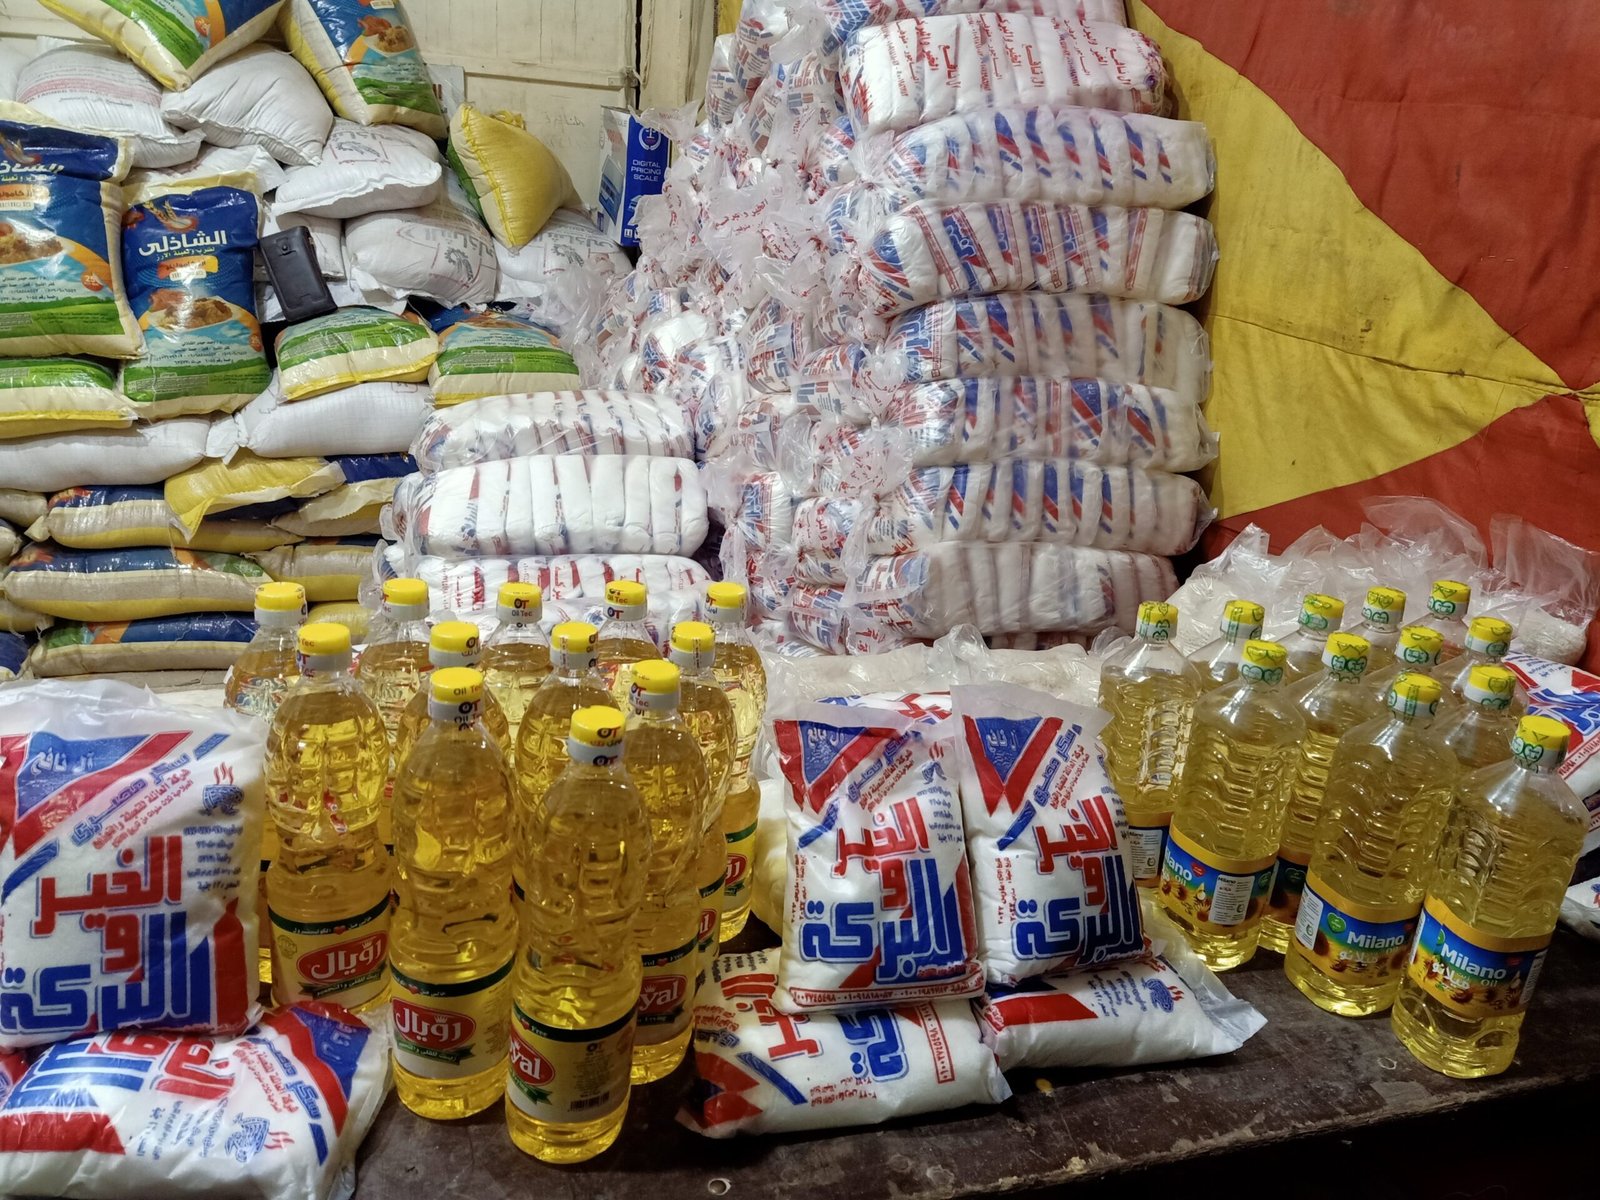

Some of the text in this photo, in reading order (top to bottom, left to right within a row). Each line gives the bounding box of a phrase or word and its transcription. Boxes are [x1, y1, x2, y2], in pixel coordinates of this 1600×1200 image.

[0, 160, 64, 174] الشاذ
[631, 166, 661, 175] PRICING
[632, 159, 661, 168] DIGITAL
[633, 173, 659, 182] SCALE
[138, 230, 228, 257] الشاذلى
[514, 598, 530, 609] OT
[615, 596, 628, 604] Tec
[607, 607, 624, 618] OT
[301, 639, 315, 647] Tec
[453, 688, 467, 696] Oil
[631, 682, 646, 694] OT
[458, 700, 478, 714] OT
[635, 699, 649, 708] Tec
[597, 727, 621, 739] OT
[1055, 729, 1077, 762] سكر
[30, 747, 67, 775] نافع
[593, 755, 618, 767] OT
[168, 769, 192, 785] شركة
[70, 753, 192, 847] سكر مصرى
[145, 782, 170, 803] العائلة
[120, 800, 147, 822] للتعبئة
[833, 797, 931, 877] الخير
[1032, 795, 1117, 876] الخير
[34, 835, 184, 936] الخير
[998, 884, 1006, 904] مارس
[1011, 855, 1146, 966] البركة
[800, 857, 965, 985] البركة
[1346, 931, 1405, 950] Milano
[311, 938, 382, 980] رويال
[1440, 943, 1507, 980] Milano
[0, 912, 212, 1032] البركة
[1480, 978, 1498, 988] Oil
[640, 979, 679, 1012] yal
[395, 1008, 462, 1043] رويال
[509, 1040, 541, 1080] yal
[284, 1080, 322, 1120] سكر
